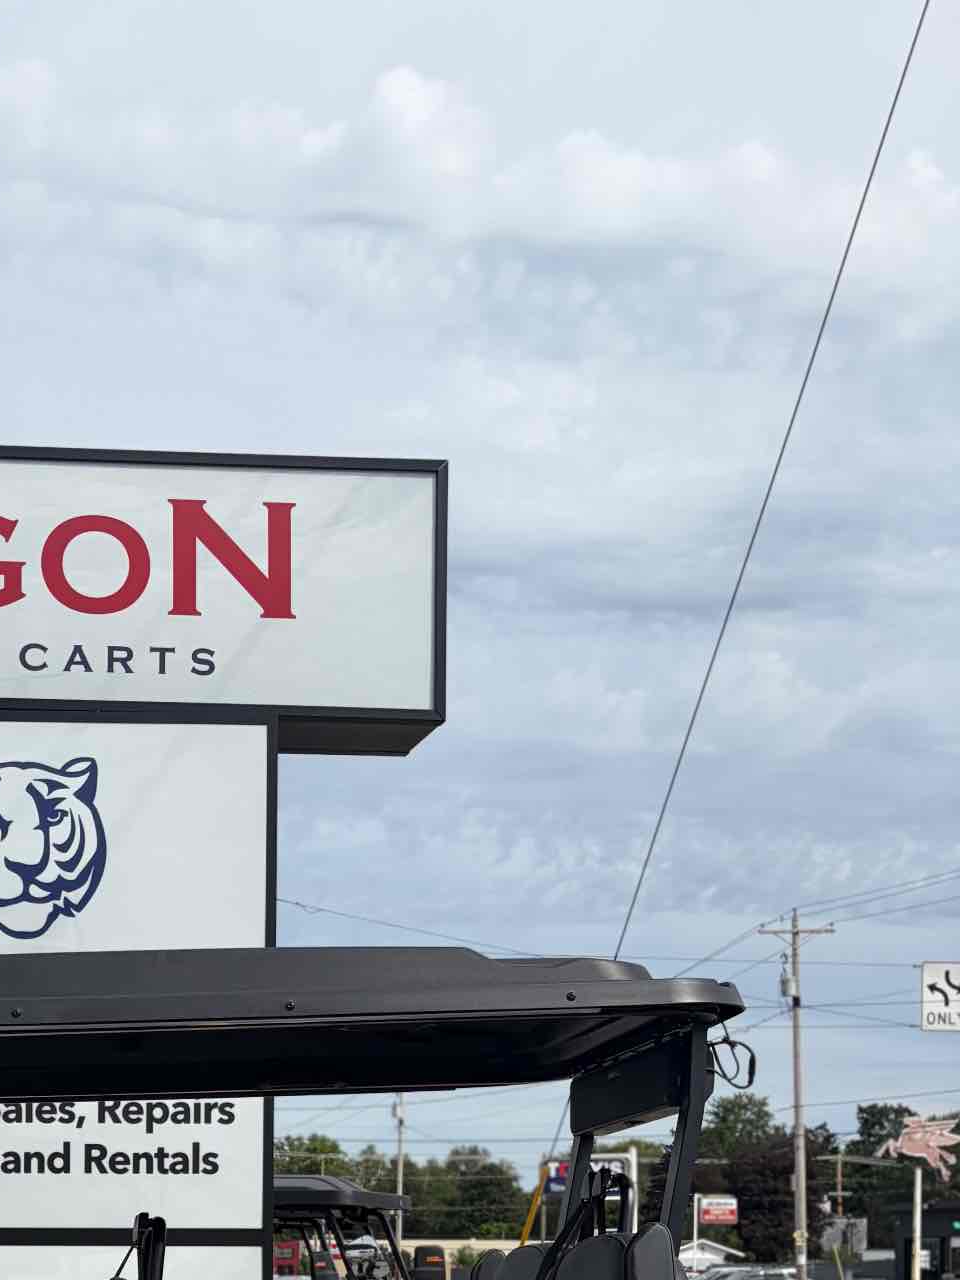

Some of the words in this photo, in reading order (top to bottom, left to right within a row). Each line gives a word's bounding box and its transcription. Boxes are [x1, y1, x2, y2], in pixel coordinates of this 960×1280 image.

[18, 642, 216, 676] CARTS
[927, 1011, 960, 1025] ONL
[97, 1099, 236, 1135] Repairs
[0, 1140, 71, 1175] and
[83, 1141, 220, 1175] Rentals
